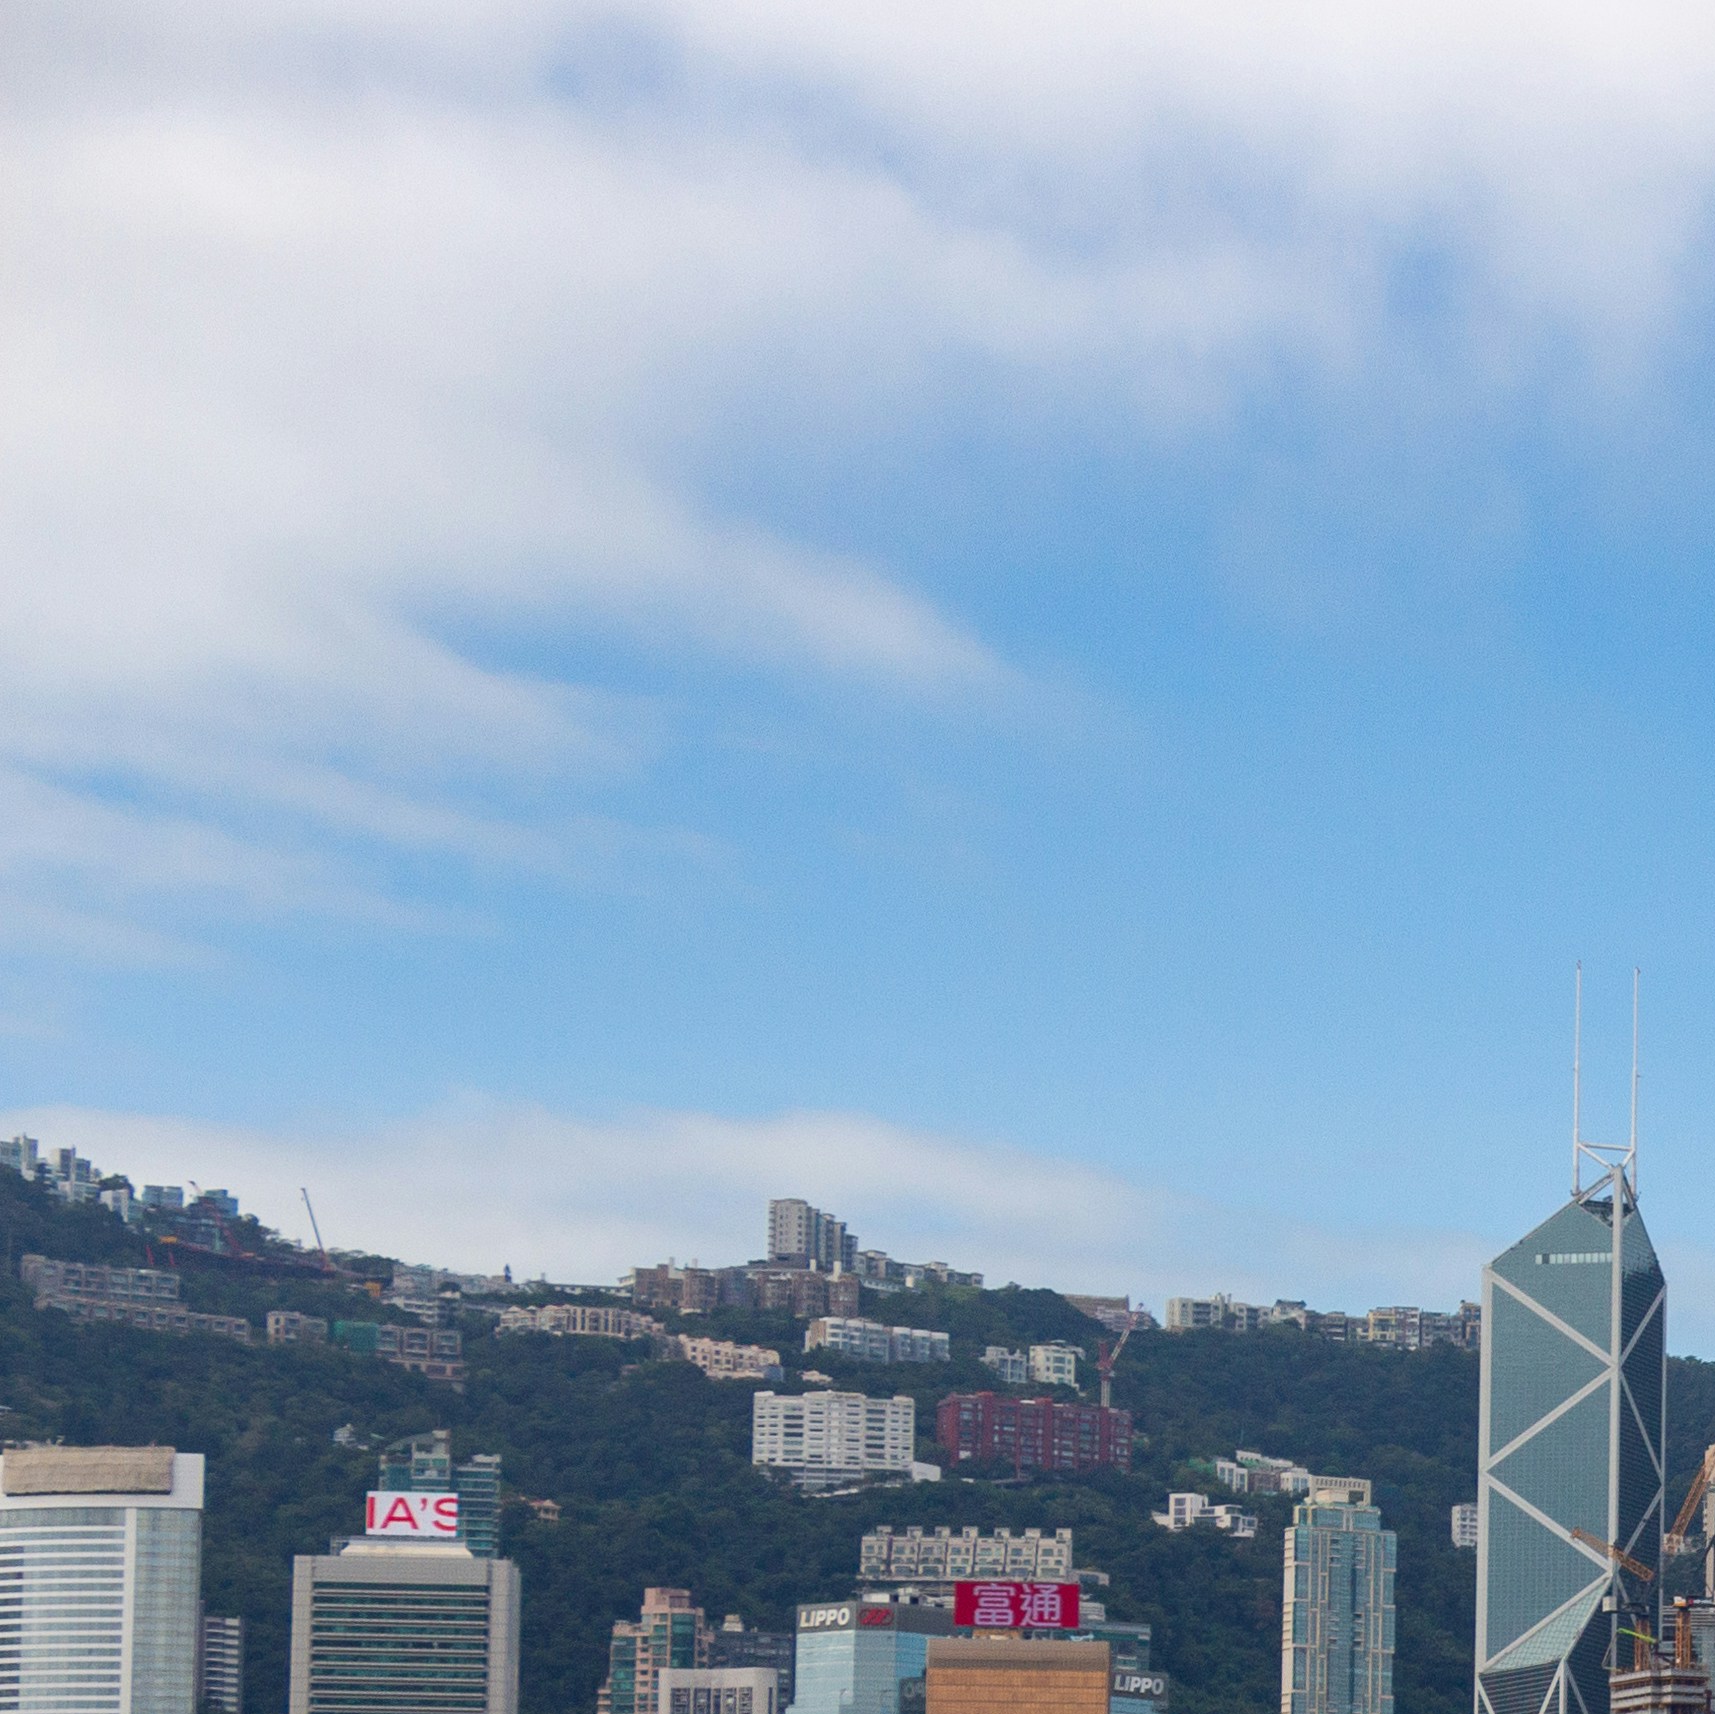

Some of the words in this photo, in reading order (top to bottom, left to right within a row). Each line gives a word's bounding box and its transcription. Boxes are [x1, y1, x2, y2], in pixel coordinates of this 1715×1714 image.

[973, 1583, 1062, 1627] 富通
[799, 1607, 851, 1628] LIPPO
[1113, 1675, 1165, 1696] LIPPO
